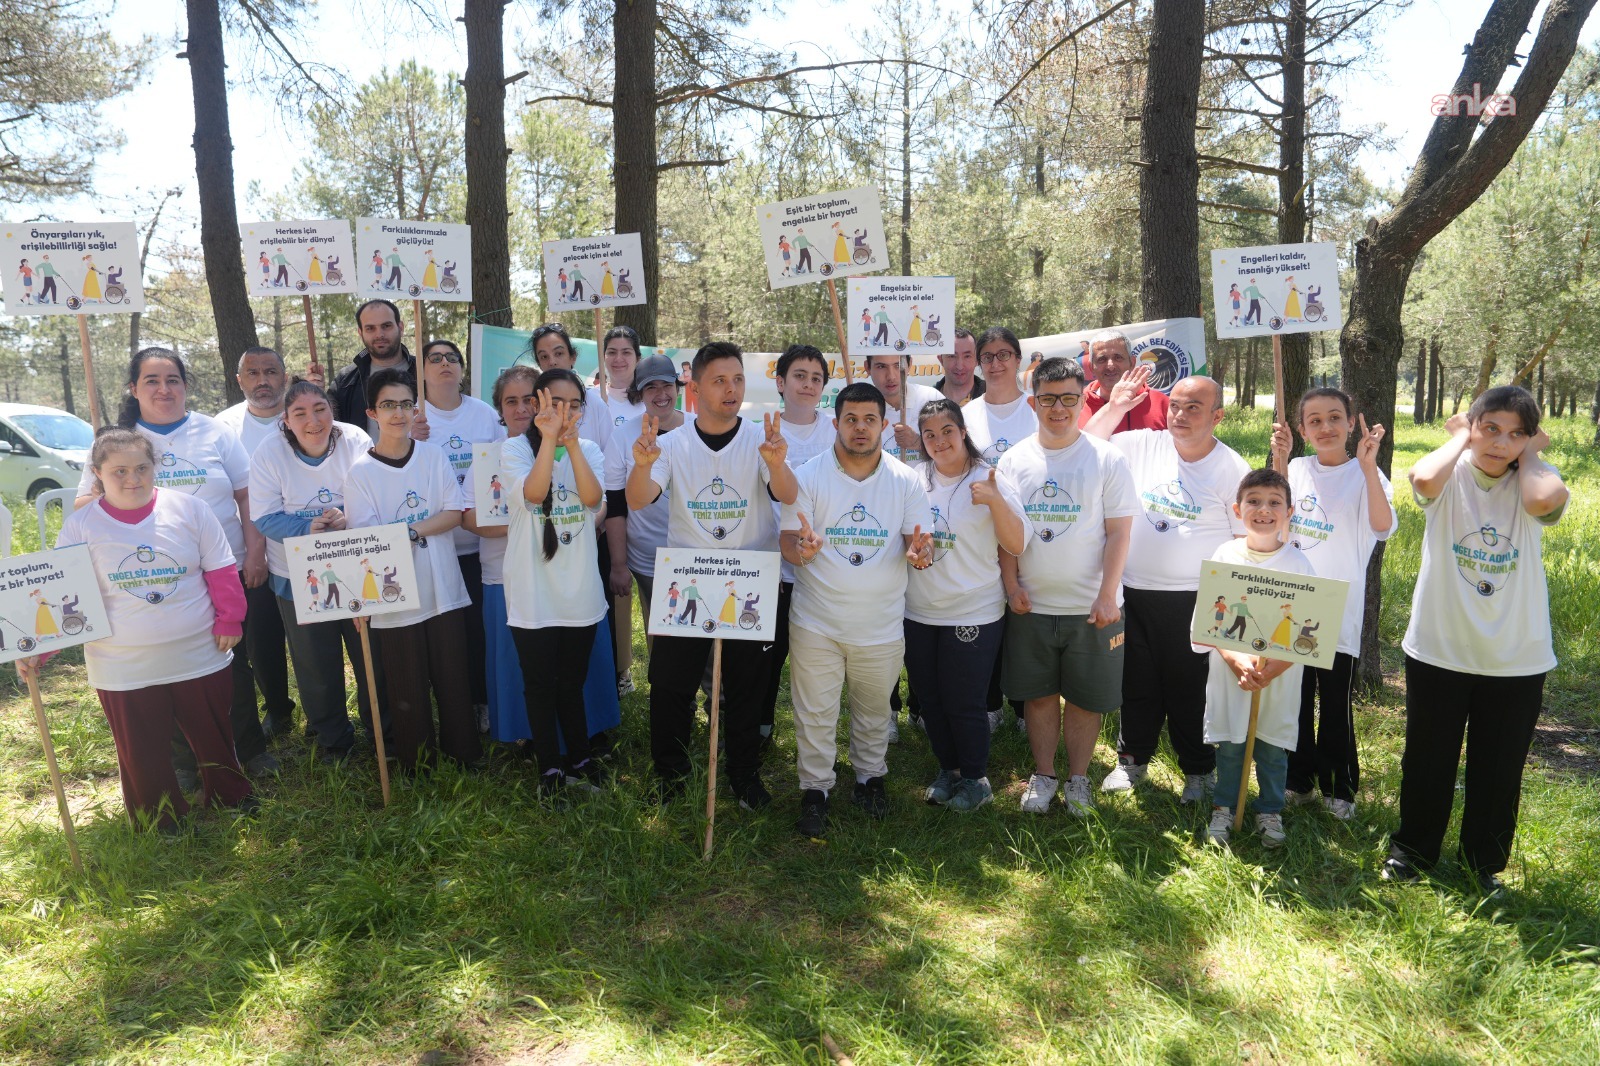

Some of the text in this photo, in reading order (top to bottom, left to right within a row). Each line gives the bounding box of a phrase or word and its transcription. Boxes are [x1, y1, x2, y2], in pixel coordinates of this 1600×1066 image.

[786, 198, 850, 215] Eşit bir toplum,
[782, 207, 858, 227] engelsiz bir hayat!
[31, 229, 104, 240] Önyargıları yık,
[303, 227, 317, 236] için
[310, 236, 335, 245] dünya!
[397, 237, 434, 246] güçlüyüz!
[88, 242, 117, 251] sağla!
[573, 243, 600, 251] Engelsiz
[563, 253, 588, 262] gelecek
[1241, 252, 1306, 264] Engelleri kaldır,
[1238, 263, 1310, 275] insanlığı yükselt!
[880, 285, 911, 293] Engelsiz
[869, 294, 897, 302] gelecek
[899, 294, 911, 302] için
[1131, 338, 1189, 365] RTAL BELEDİYESİ
[173, 469, 207, 478] ADIMLAR
[167, 477, 206, 487] YARINLAR
[688, 499, 748, 510] ENGELSİZ ADIMLAR
[693, 510, 746, 519] TEMİZ YARINLAR
[1043, 514, 1077, 522] YARINLAR
[1303, 518, 1334, 532] ADIMLAR
[825, 526, 888, 537] ENGELSİZ ADIMLAR
[1295, 525, 1328, 541] YARINLAR
[315, 534, 379, 549] Önyargıları yık,
[829, 536, 885, 547] TEMİZ YARINLAR
[365, 544, 390, 553] sağla!
[1452, 544, 1487, 561] NGELSİZ
[694, 556, 740, 566] Herkes için
[8, 562, 53, 577] toplum,
[108, 567, 187, 581] ENGELSİZ ADIMLAR
[731, 569, 760, 578] dünya!
[9, 580, 24, 589] bir
[26, 570, 64, 585] hayat!
[117, 580, 144, 589] TEMİZ
[1231, 571, 1315, 592] Farklılıklarımızla
[1247, 586, 1295, 600] güçlüyüz!
